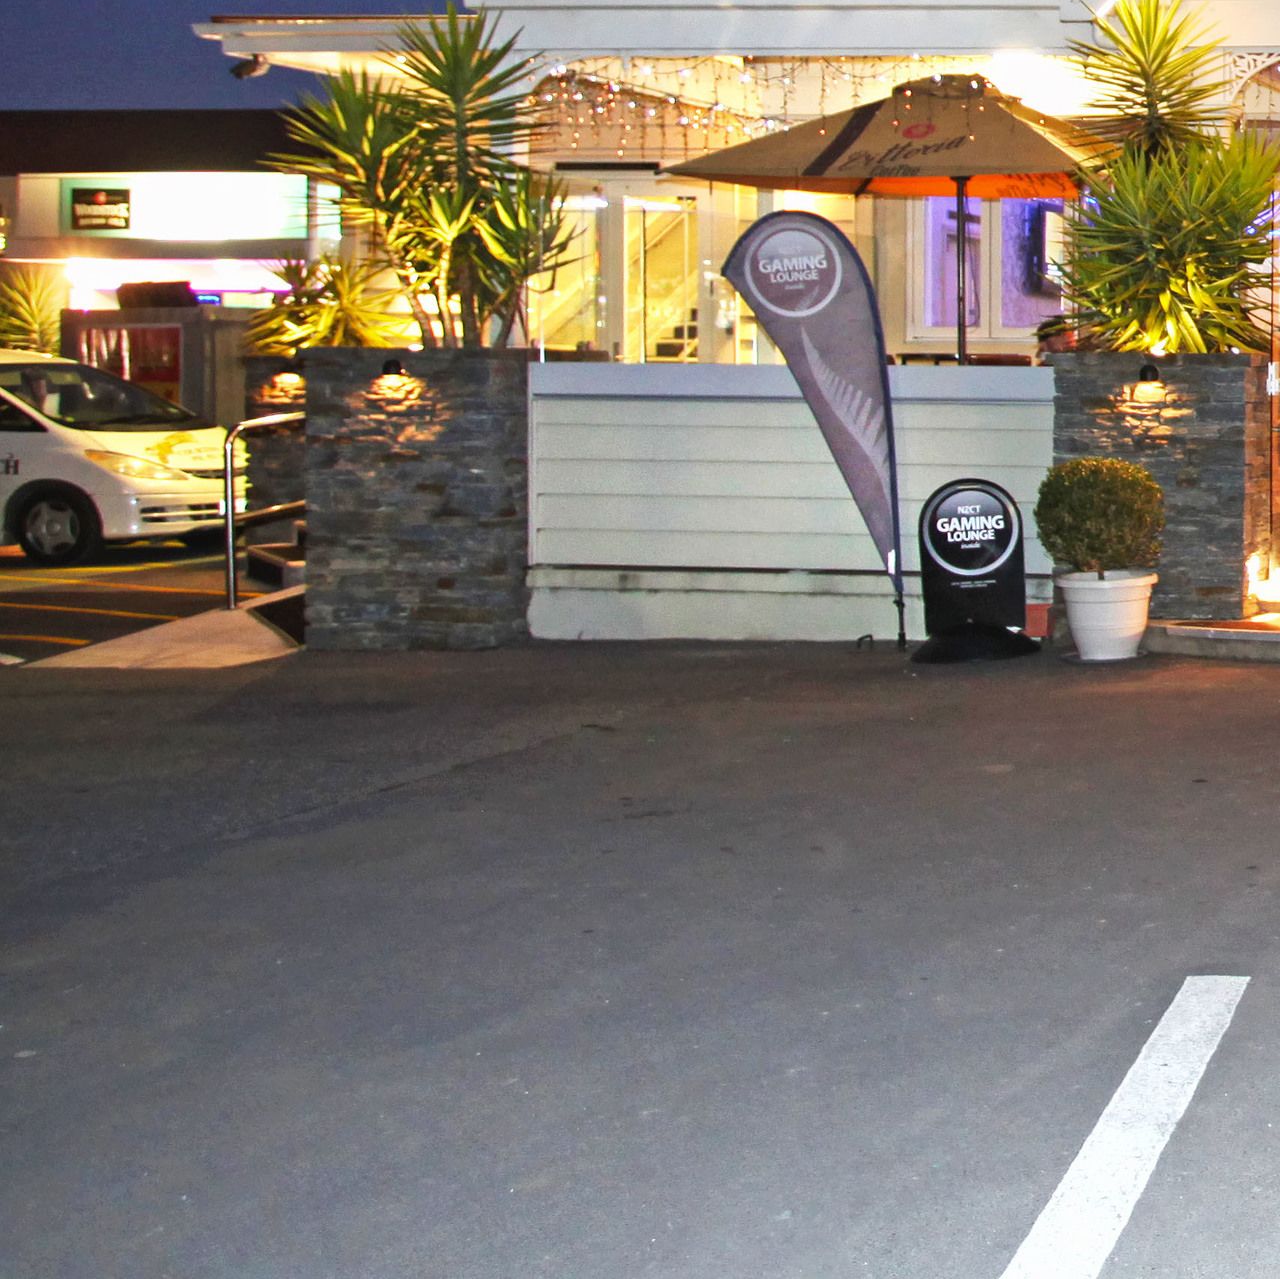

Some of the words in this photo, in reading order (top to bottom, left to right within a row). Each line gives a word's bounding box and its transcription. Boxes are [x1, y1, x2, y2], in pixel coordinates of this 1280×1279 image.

[758, 255, 828, 274] GAMING
[770, 270, 819, 283] LOUNGE
[936, 515, 1005, 532] GAMING
[947, 529, 996, 542] LOUNGE
